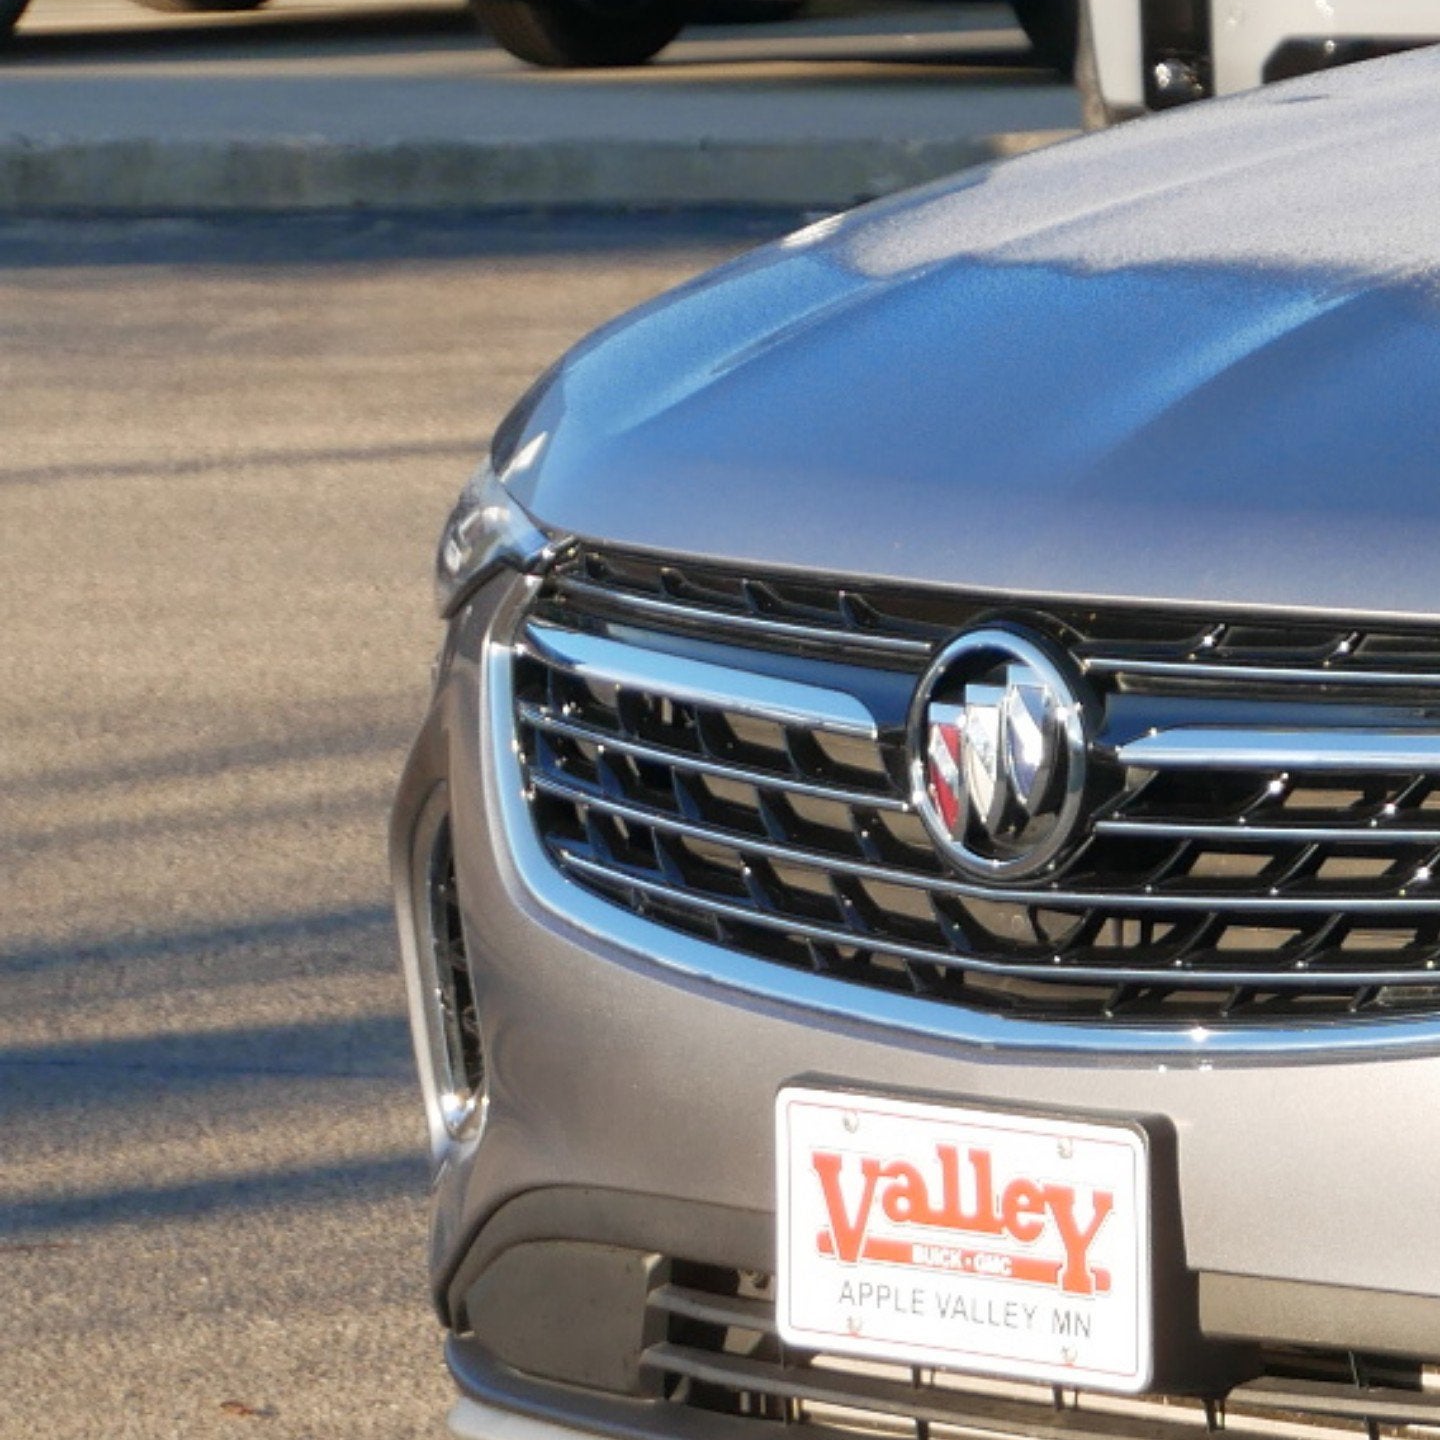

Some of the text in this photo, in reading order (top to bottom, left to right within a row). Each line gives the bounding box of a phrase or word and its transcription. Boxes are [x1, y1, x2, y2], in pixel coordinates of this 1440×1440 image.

[913, 1242, 962, 1269] BUICK
[839, 1279, 1092, 1338] APPLE VALLEY MN
